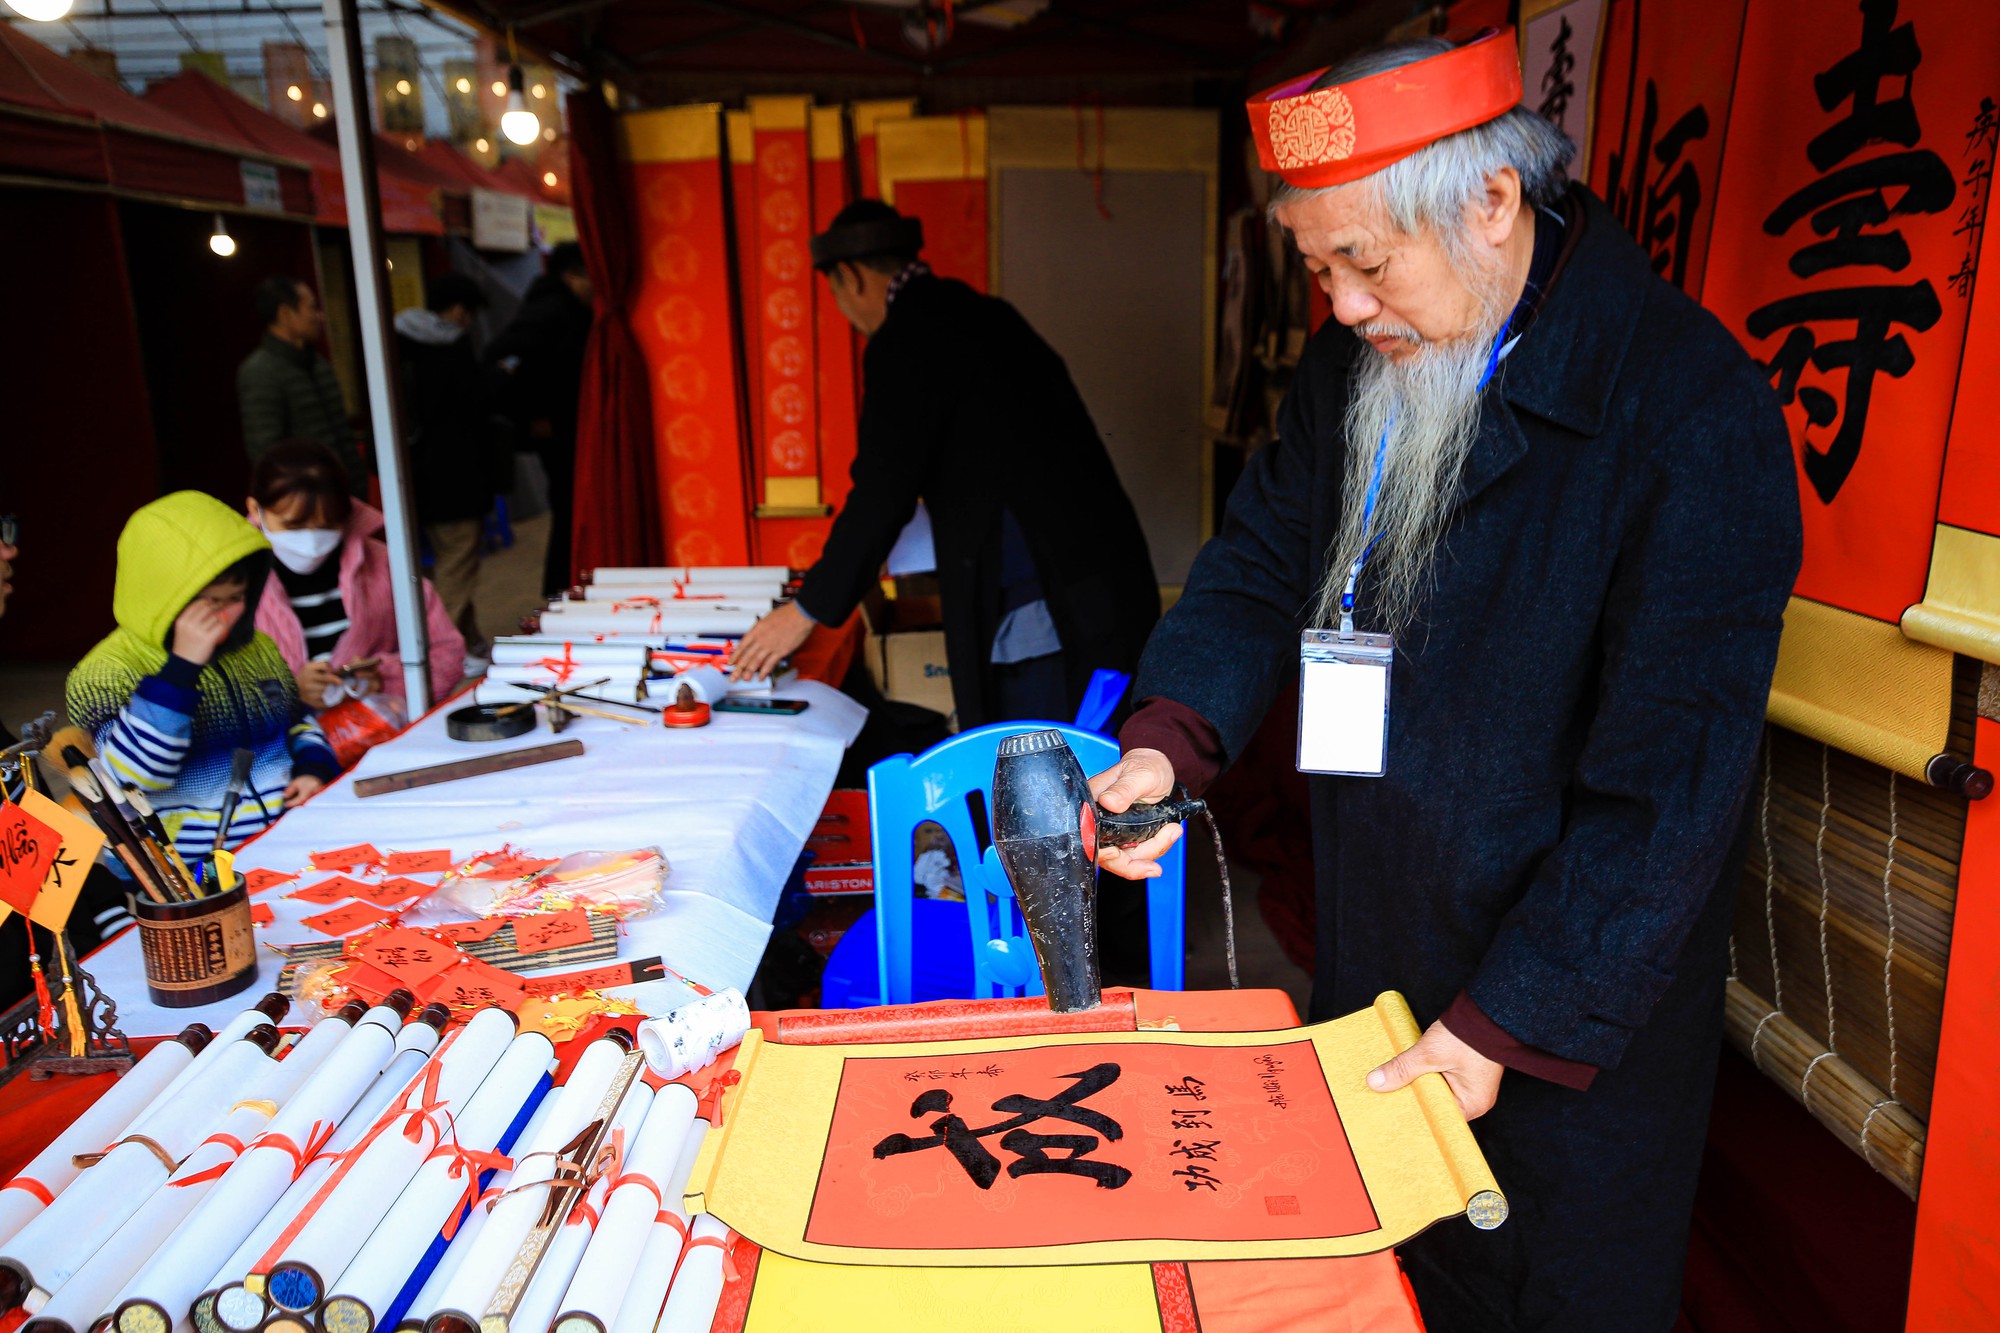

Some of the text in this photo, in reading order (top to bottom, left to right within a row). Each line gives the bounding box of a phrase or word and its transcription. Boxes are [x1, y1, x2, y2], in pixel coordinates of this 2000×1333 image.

[1747, 0, 1957, 505] 壽
[804, 878, 873, 891] ARISTON
[872, 1062, 1133, 1191] 成
[1164, 1075, 1223, 1193] 馬到成功
